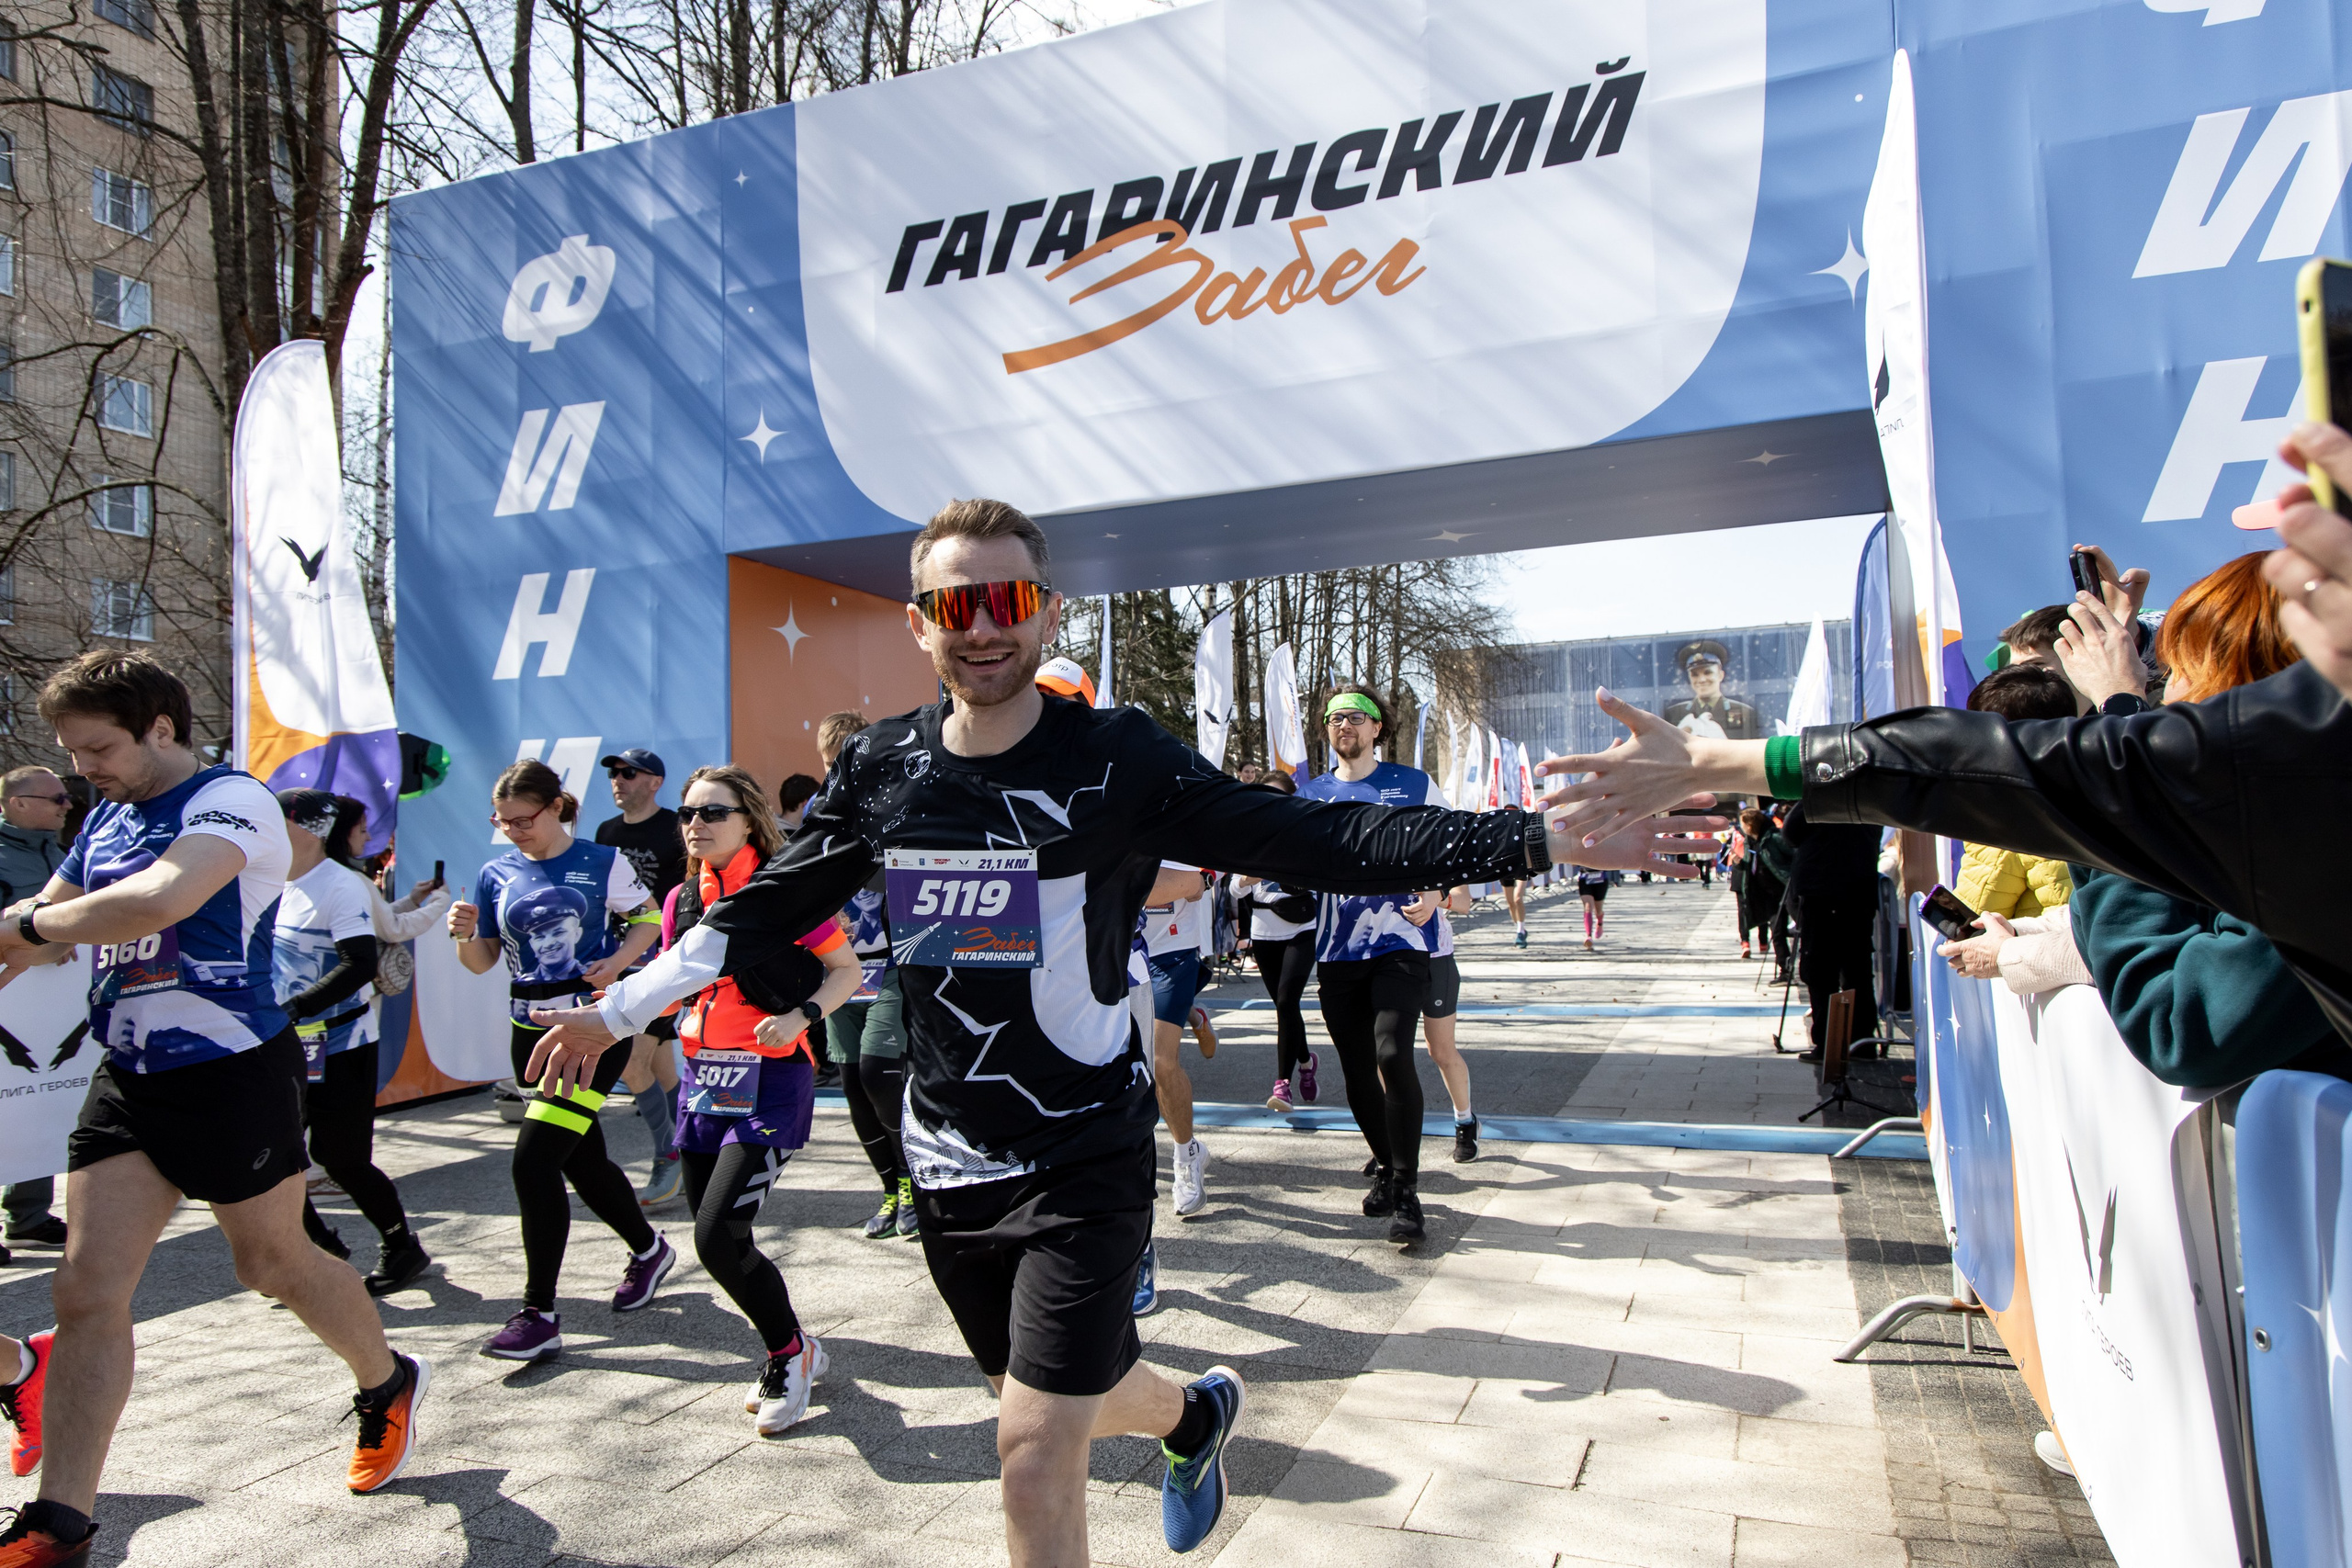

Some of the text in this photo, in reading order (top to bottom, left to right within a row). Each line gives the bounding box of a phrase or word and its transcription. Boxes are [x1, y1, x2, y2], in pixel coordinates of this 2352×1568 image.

[885, 56, 1646, 294] ГАГАРИНСКИЙ
[1002, 215, 1427, 375] Забег
[978, 859, 1030, 872] 21,1 КМ
[912, 879, 1012, 917] 5119
[97, 932, 162, 969] 5160
[954, 927, 1037, 953] Забег
[952, 950, 1035, 962] ГАГАРИНСКИЙ
[119, 977, 179, 995] ГАГАРИНСКИЙ
[0, 1077, 89, 1100] ЛИГА ГЕРОЕВ
[695, 1065, 750, 1088] 5017
[2097, 1325, 2133, 1382] ГЕРОЕВ
